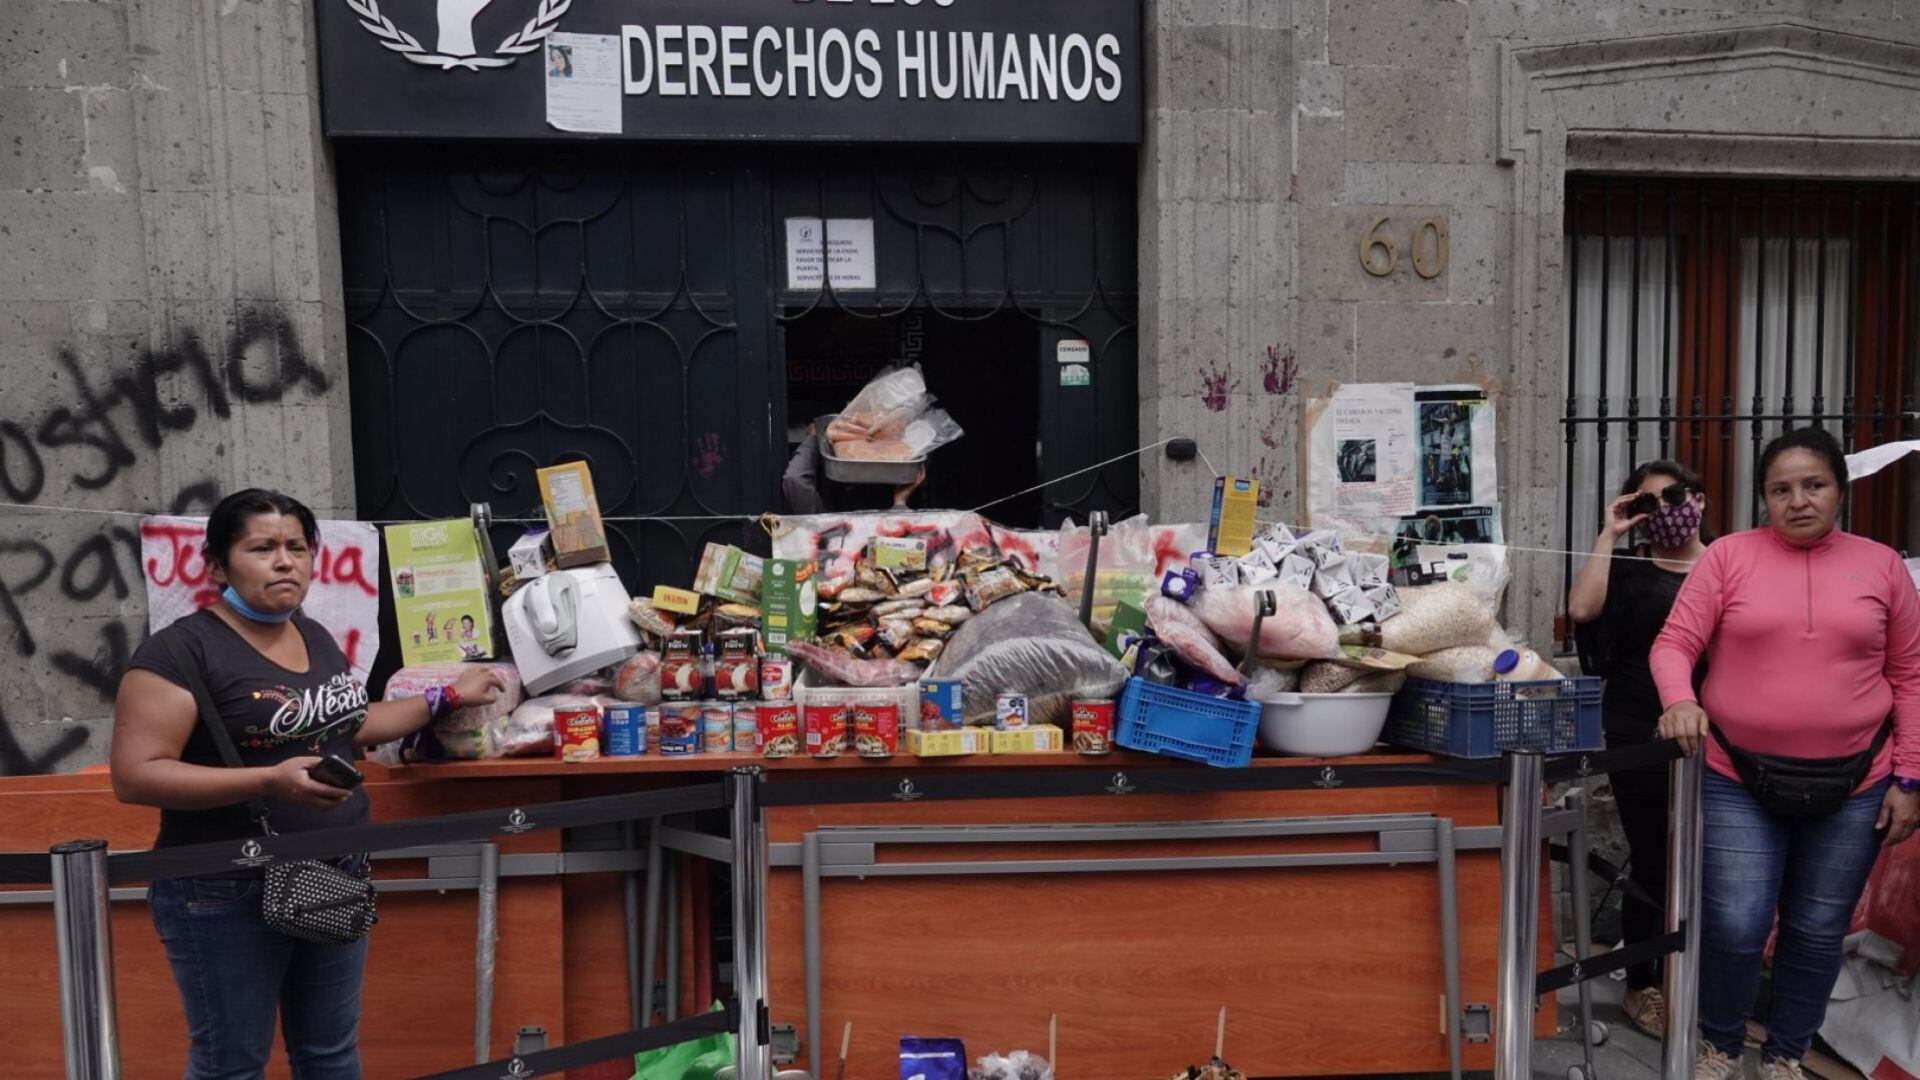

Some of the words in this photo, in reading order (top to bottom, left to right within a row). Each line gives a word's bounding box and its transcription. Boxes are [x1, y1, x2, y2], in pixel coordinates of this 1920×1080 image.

[623, 24, 883, 98] DERECHOS
[897, 30, 1122, 102] HUMANOS
[1359, 216, 1450, 279] 60
